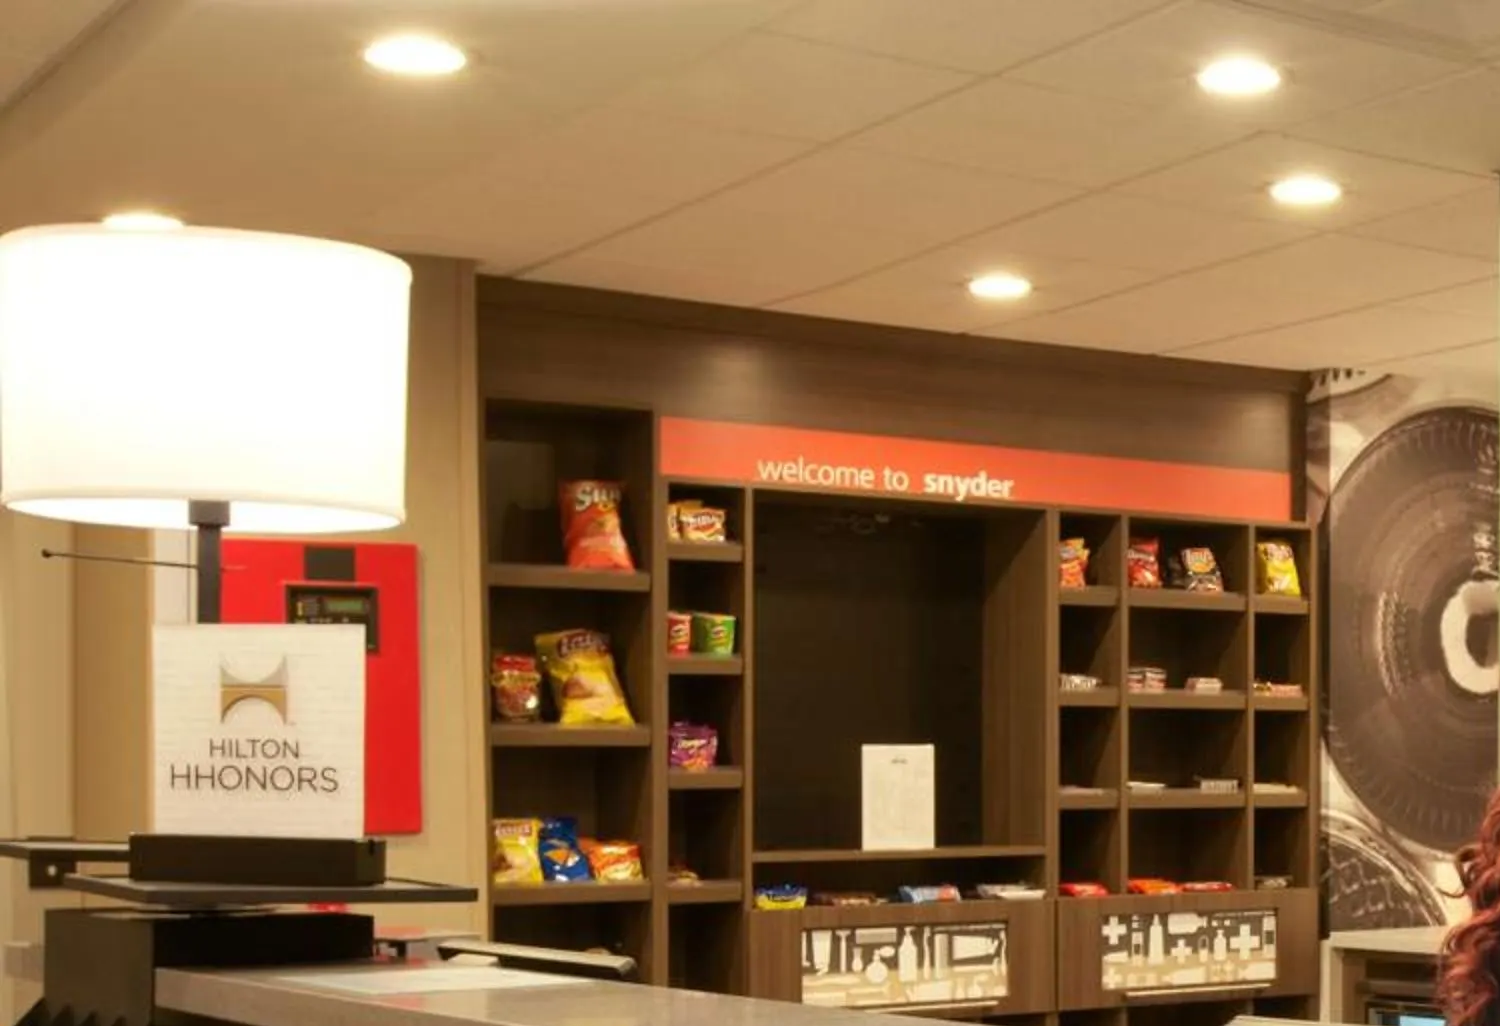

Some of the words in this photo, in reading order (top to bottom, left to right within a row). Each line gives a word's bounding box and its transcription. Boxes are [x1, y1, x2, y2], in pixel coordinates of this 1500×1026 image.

[757, 456, 875, 489] welcome
[883, 466, 909, 491] to
[923, 471, 1015, 502] snyder
[209, 738, 300, 760] HILTON
[170, 764, 339, 793] HHONORS
